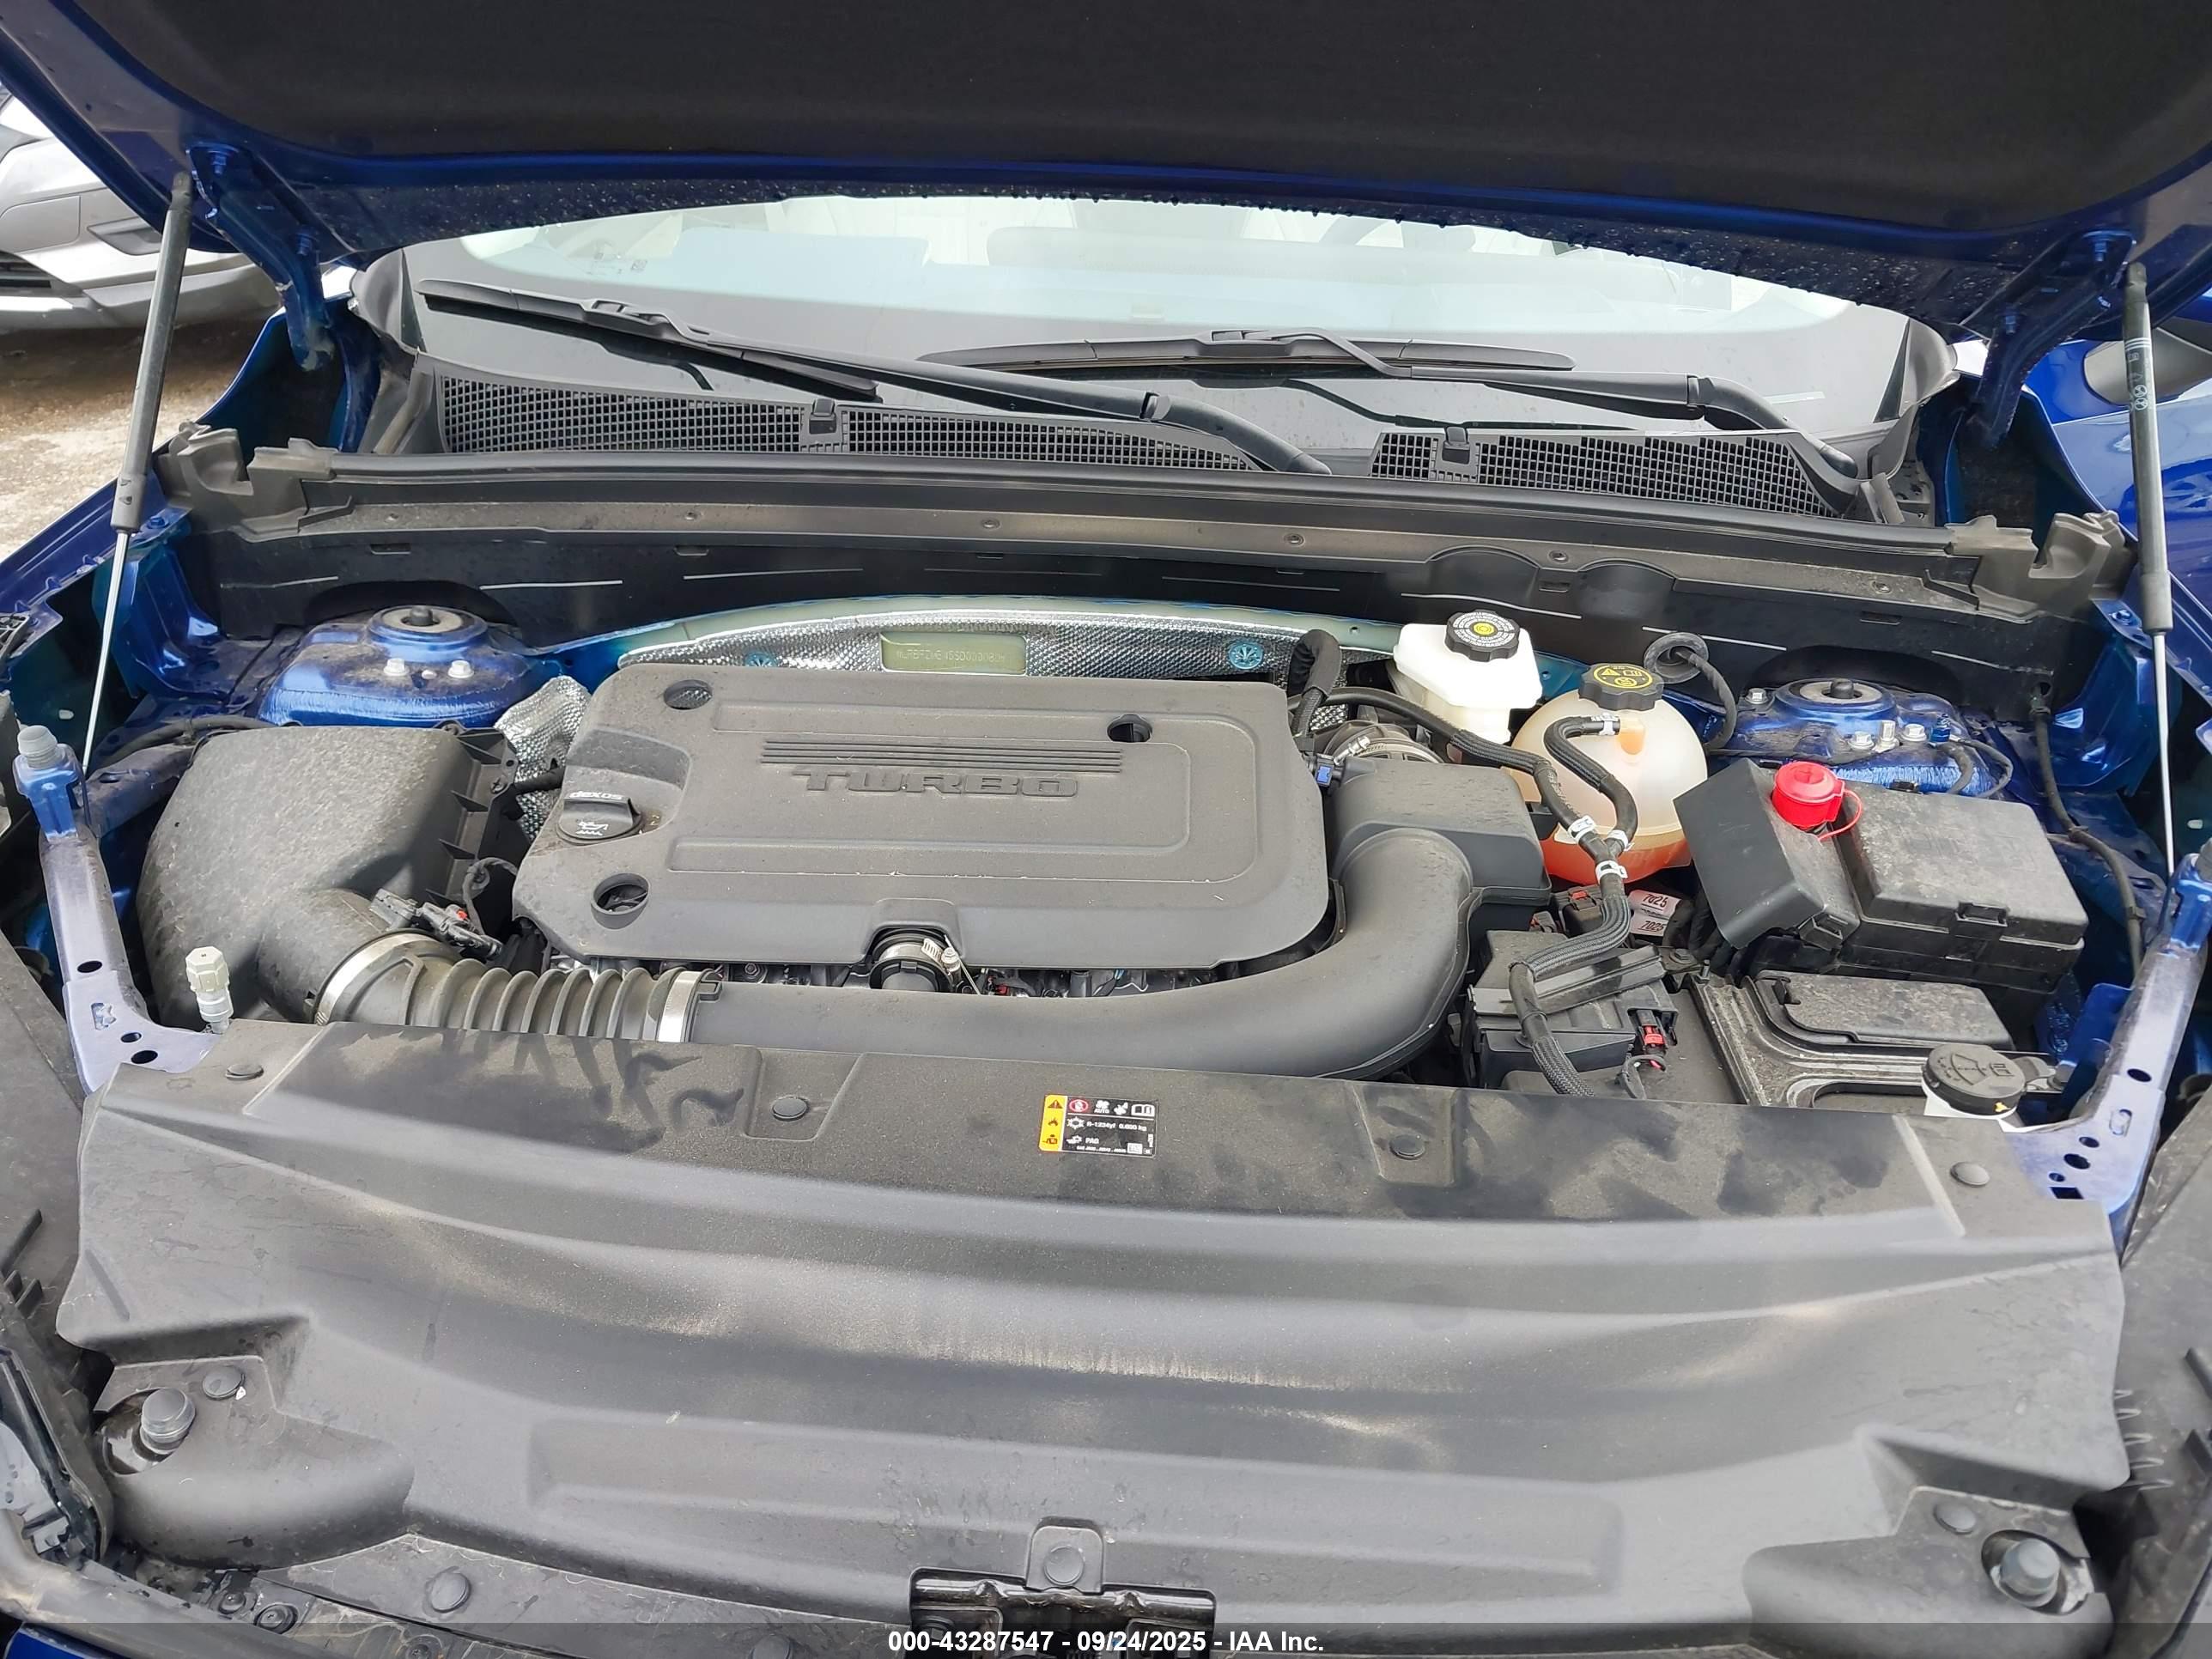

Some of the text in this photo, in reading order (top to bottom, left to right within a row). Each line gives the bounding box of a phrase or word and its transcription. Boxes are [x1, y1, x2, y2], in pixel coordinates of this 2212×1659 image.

[792, 770, 1079, 798] TURBO
[569, 791, 624, 800] dexos
[1643, 894, 1668, 908] 7025
[1641, 921, 1666, 932] 7025
